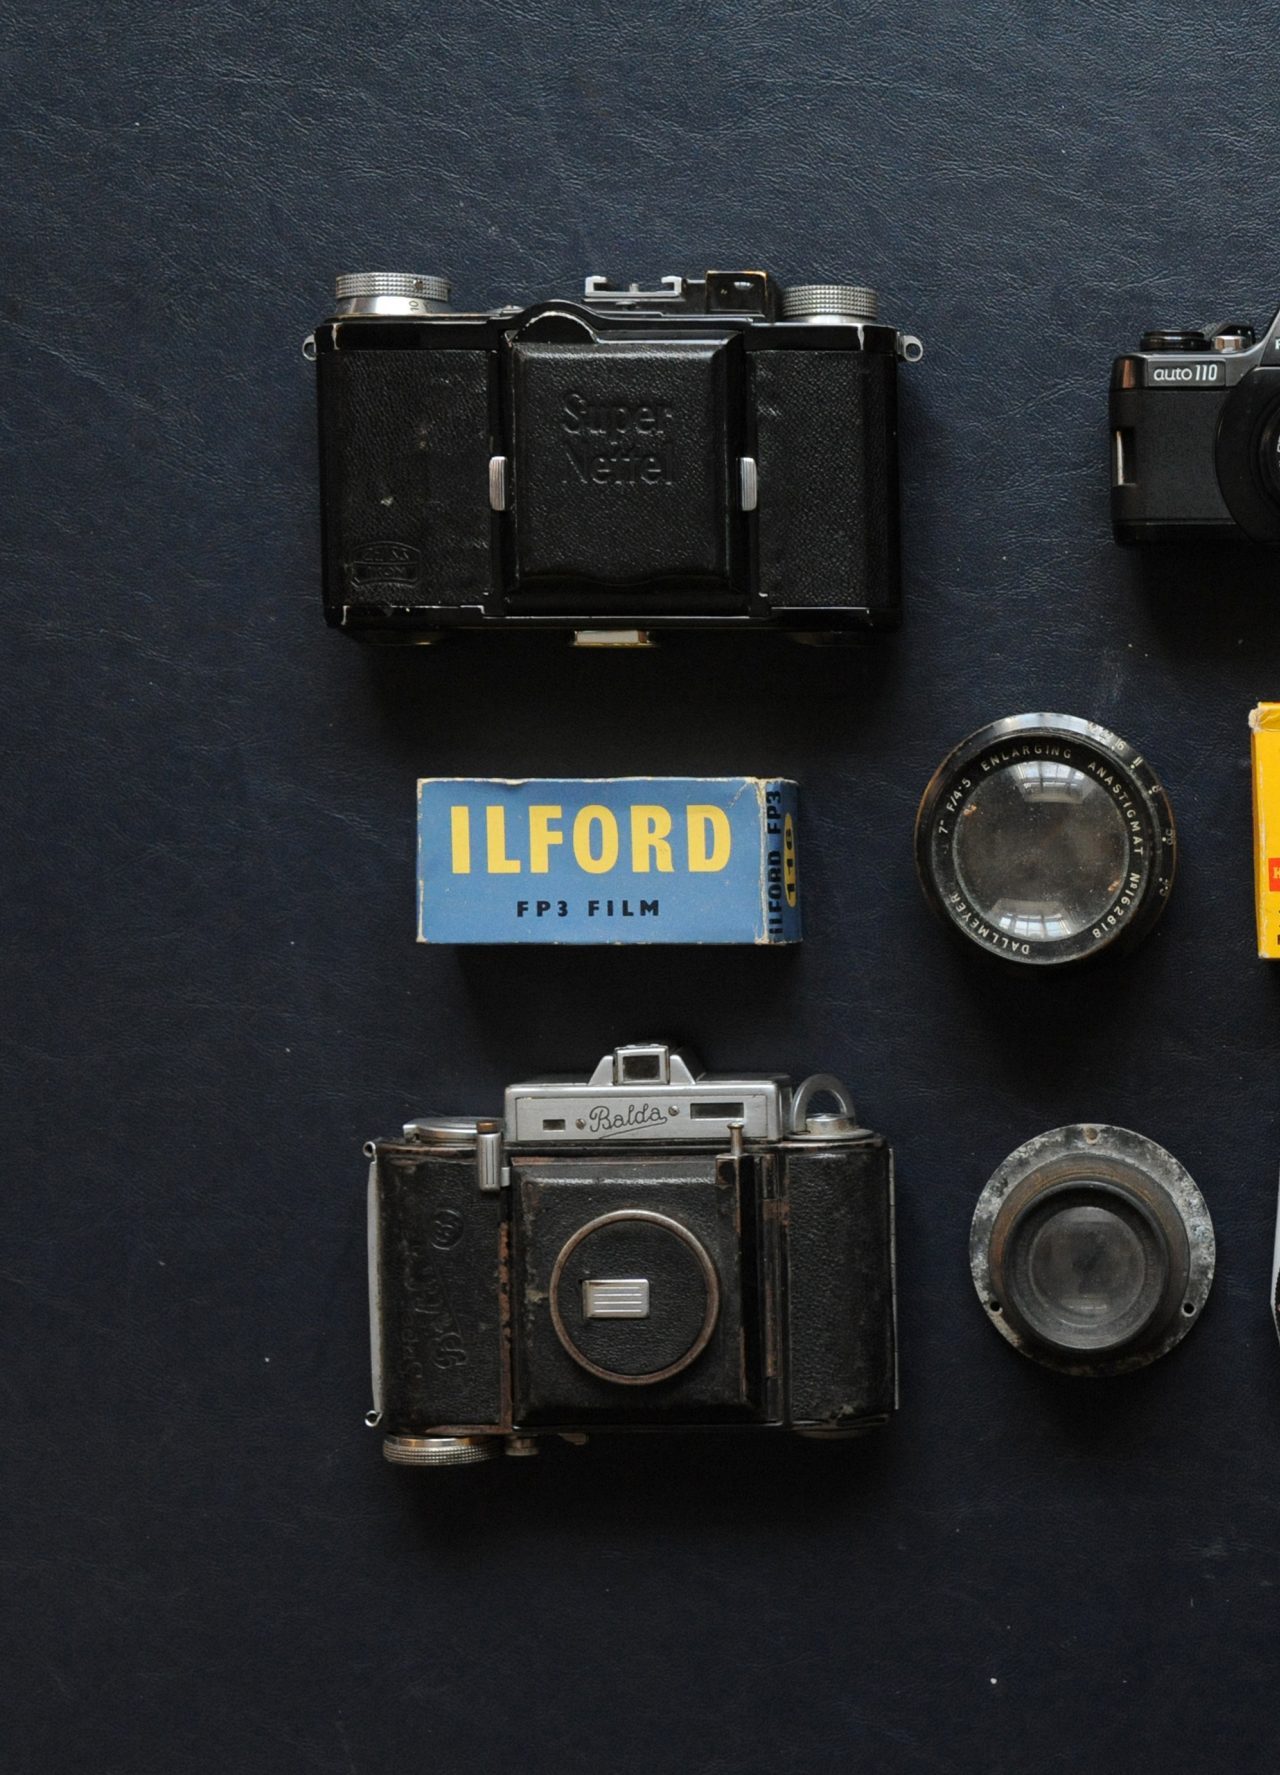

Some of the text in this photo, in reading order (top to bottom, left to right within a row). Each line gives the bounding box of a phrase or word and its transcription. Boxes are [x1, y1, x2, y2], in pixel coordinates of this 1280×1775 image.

[561, 391, 673, 446] Super
[980, 744, 1073, 772] ENLARGING
[1087, 761, 1144, 856] ANASTIGMAT
[451, 804, 732, 875] ILFORD
[765, 790, 784, 935] ILFORD FP3
[516, 899, 660, 918] FP3 FILM
[949, 892, 1031, 955] DALLMEYER
[589, 1103, 668, 1138] Balda
